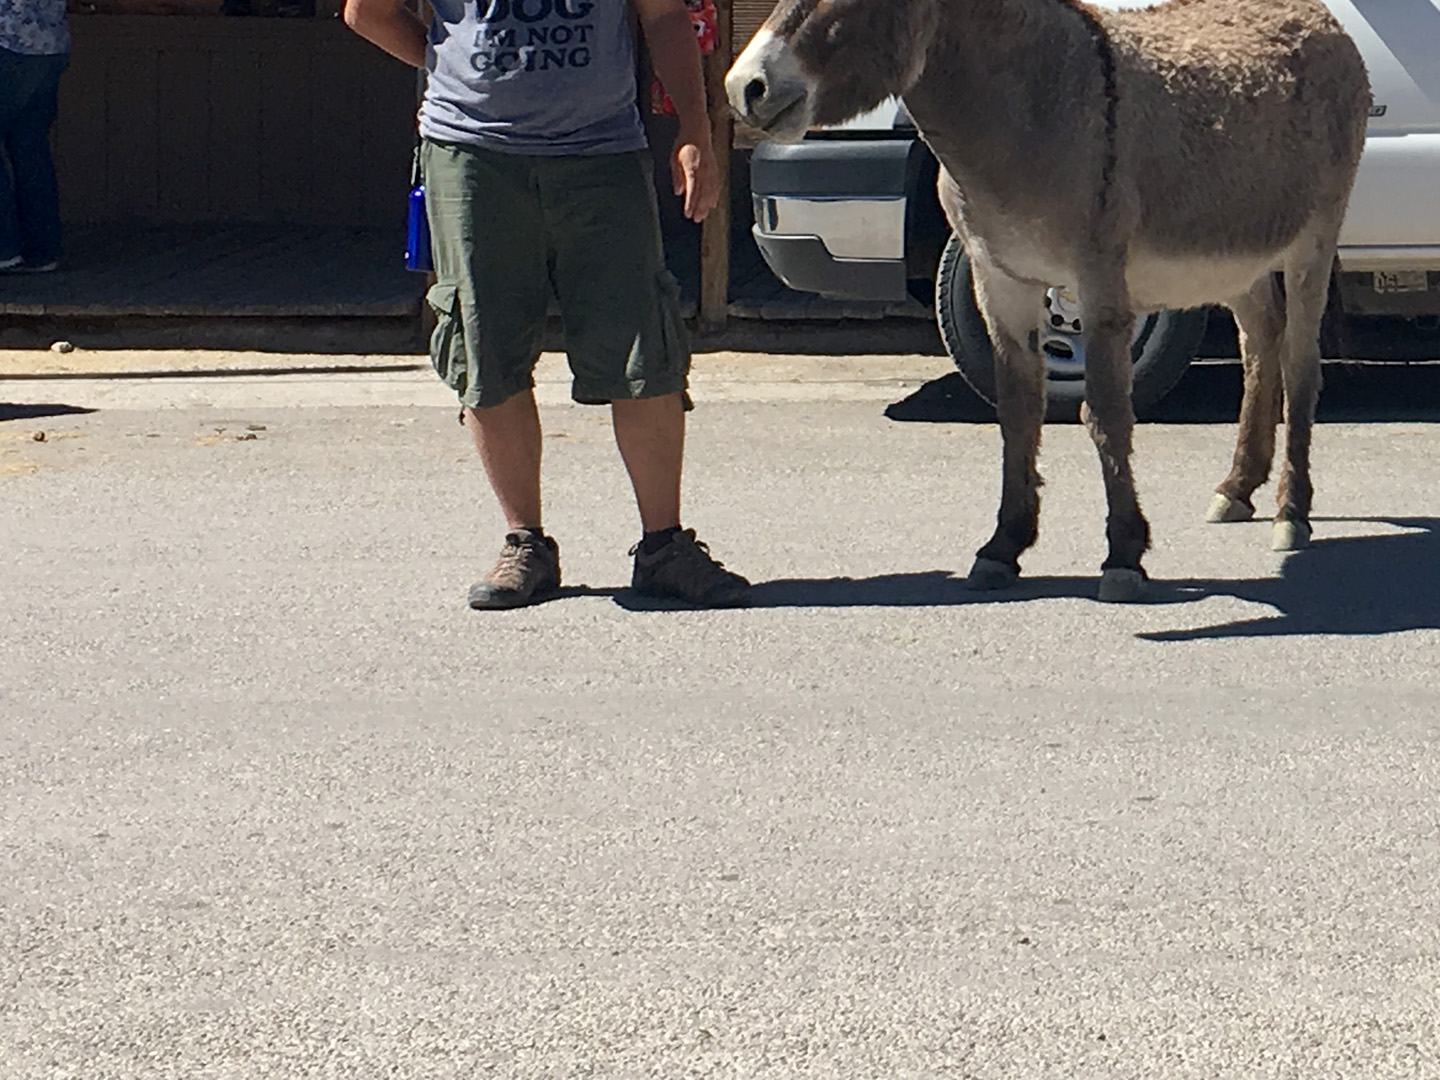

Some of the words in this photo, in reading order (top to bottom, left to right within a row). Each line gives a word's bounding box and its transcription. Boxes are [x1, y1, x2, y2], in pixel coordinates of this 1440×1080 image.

[473, 28, 516, 48] I'M
[527, 24, 593, 46] NOT
[470, 47, 592, 72] GOING
